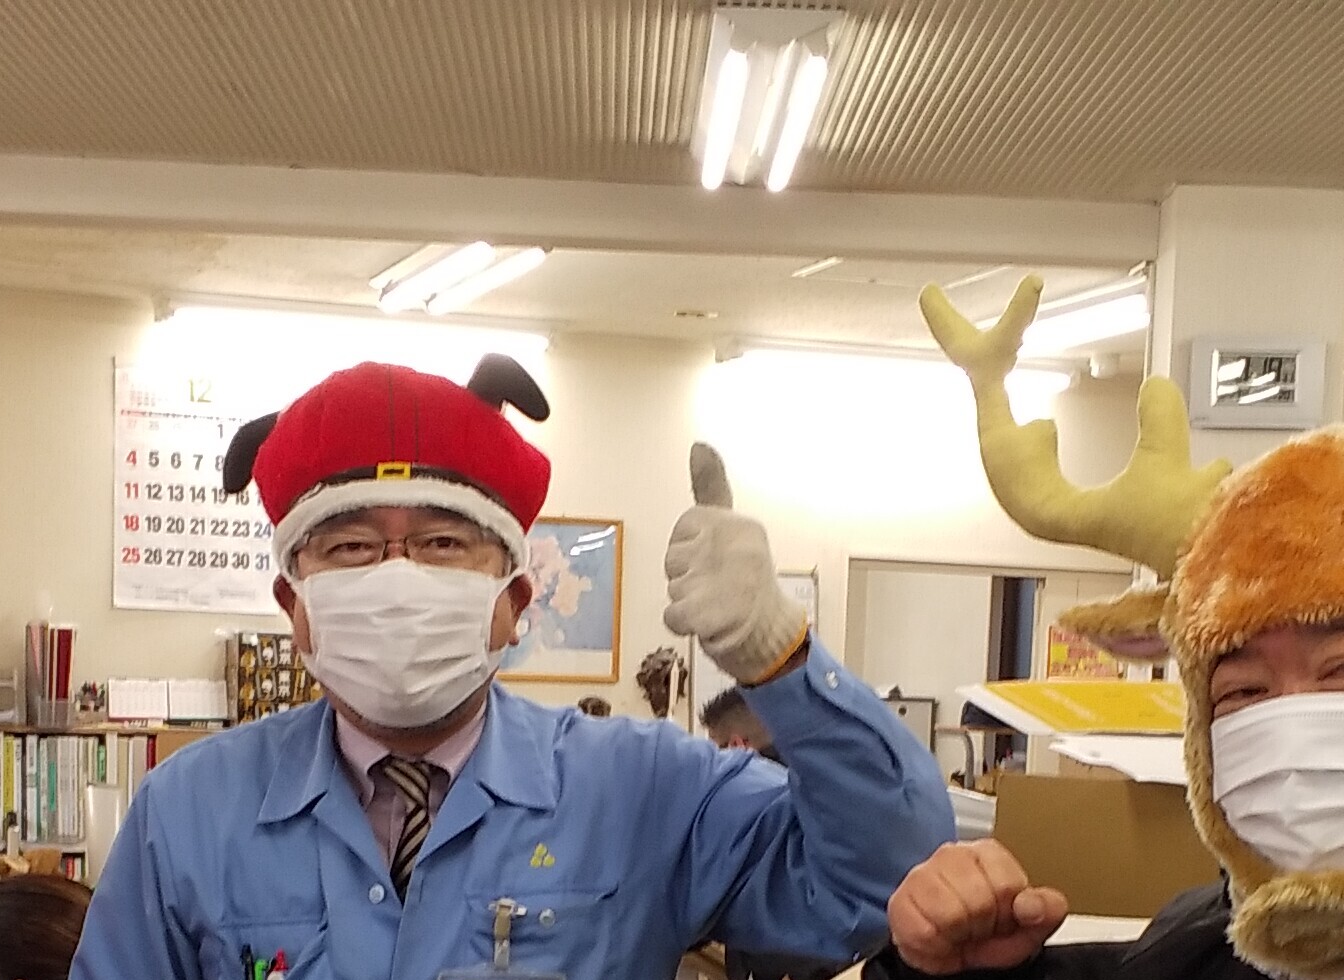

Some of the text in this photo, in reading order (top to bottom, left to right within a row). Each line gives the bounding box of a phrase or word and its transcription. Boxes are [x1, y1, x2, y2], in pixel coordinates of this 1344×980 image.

[217, 423, 224, 439] 1
[126, 450, 137, 466] 4
[148, 451, 160, 467] 5
[171, 452, 182, 469] 6
[192, 454, 204, 470] 7
[125, 482, 139, 499] 11
[145, 483, 162, 500] 12
[167, 485, 184, 502] 13
[189, 486, 206, 503] 14
[123, 515, 272, 539] 18 19 20 21 22 23 24
[122, 547, 271, 570] 25 26 27 28 29 30 31
